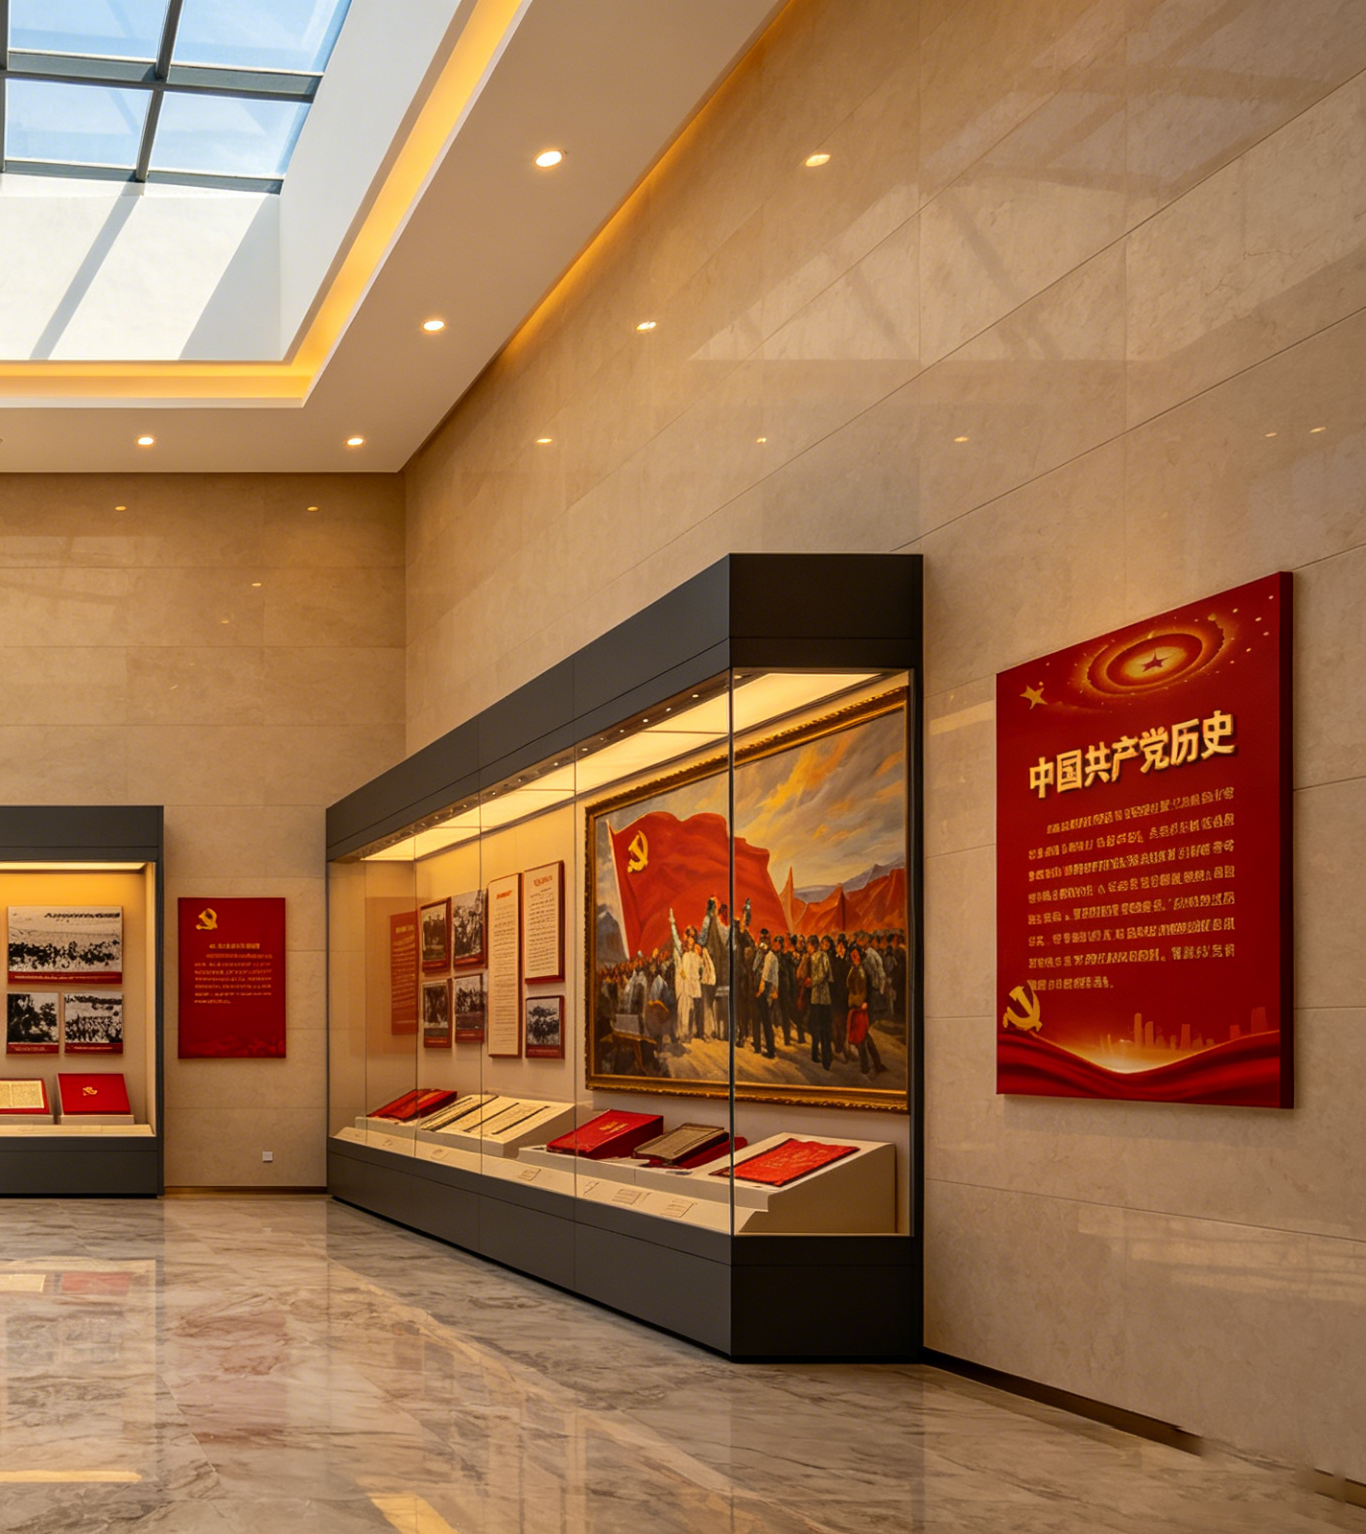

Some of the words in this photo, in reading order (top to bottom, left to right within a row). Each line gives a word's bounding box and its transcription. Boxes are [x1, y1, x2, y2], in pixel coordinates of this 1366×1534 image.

[1029, 710, 1235, 798] 中国共产党历史
